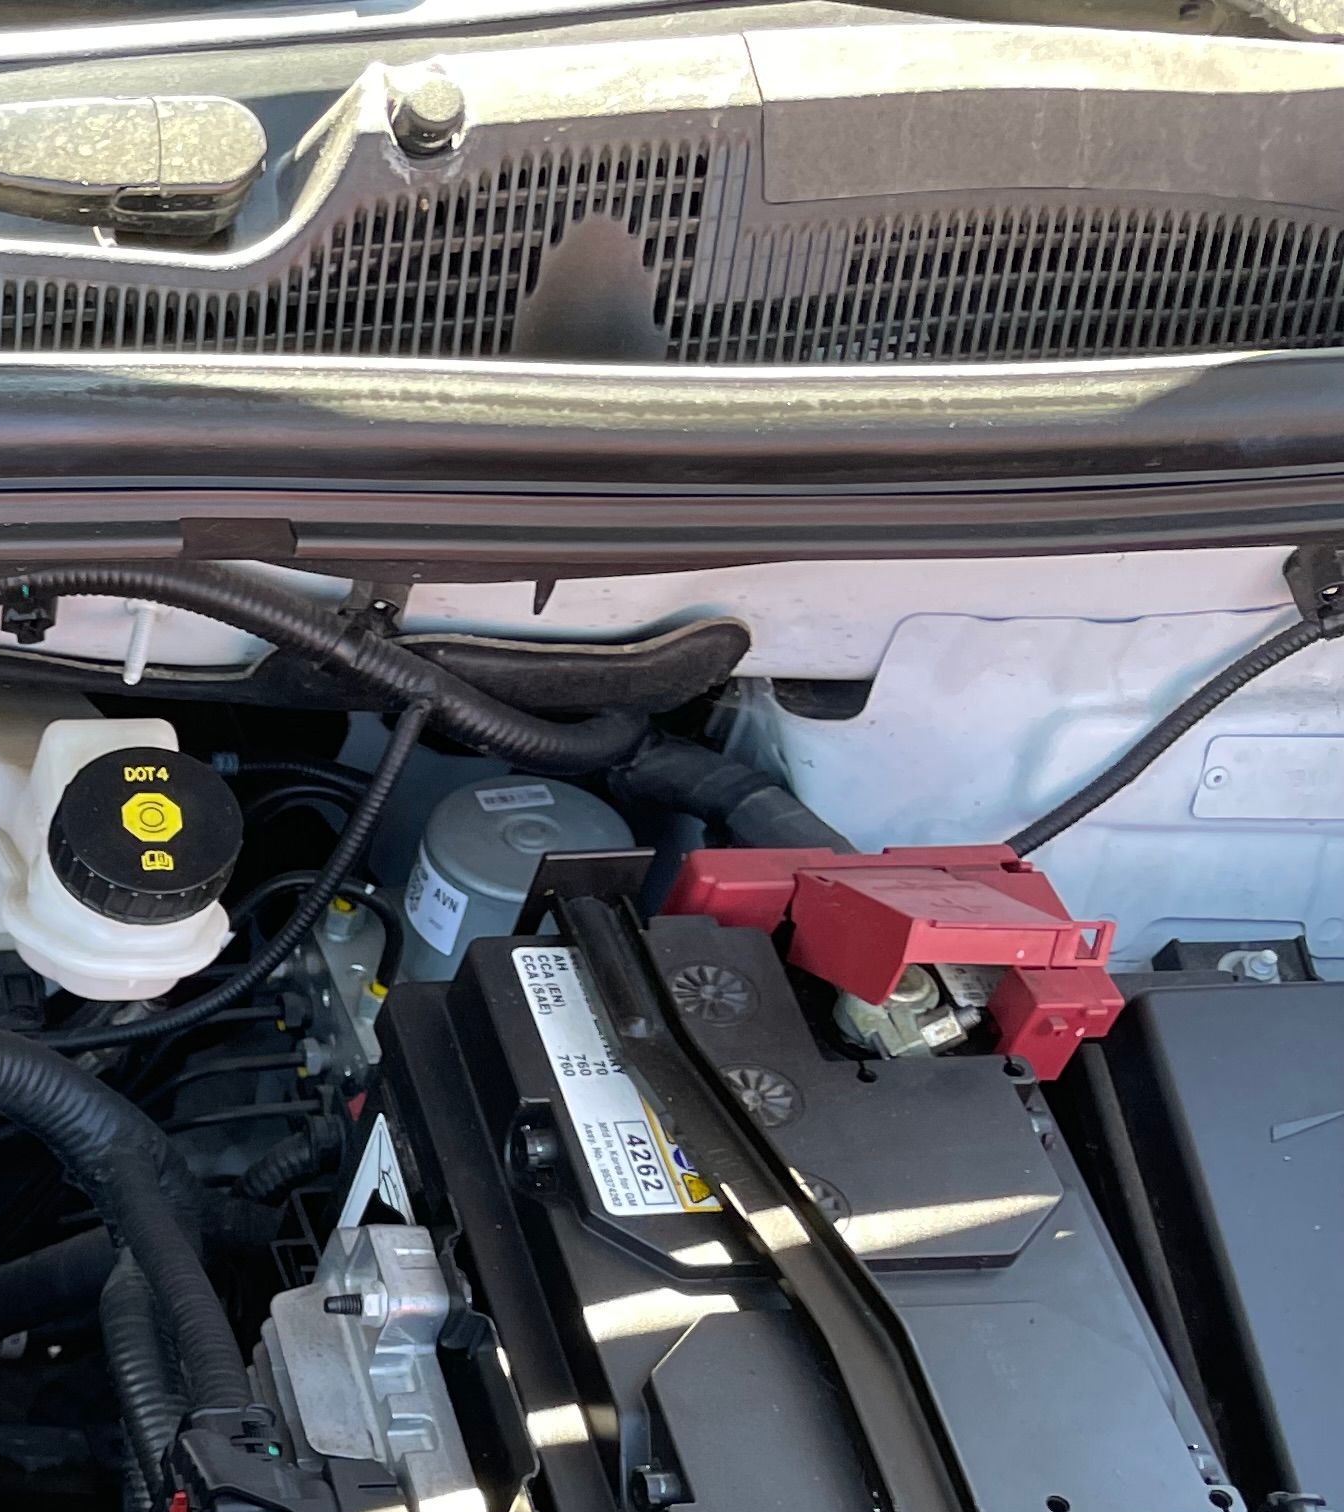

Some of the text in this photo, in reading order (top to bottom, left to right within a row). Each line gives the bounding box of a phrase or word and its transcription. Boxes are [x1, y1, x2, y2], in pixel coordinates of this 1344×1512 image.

[432, 888, 459, 913] AVN
[521, 954, 576, 1077] CCA (SAE) 760
[538, 954, 592, 1076] CCA (EN) 760
[552, 954, 609, 1076] AH 70
[626, 1133, 664, 1192] 4262
